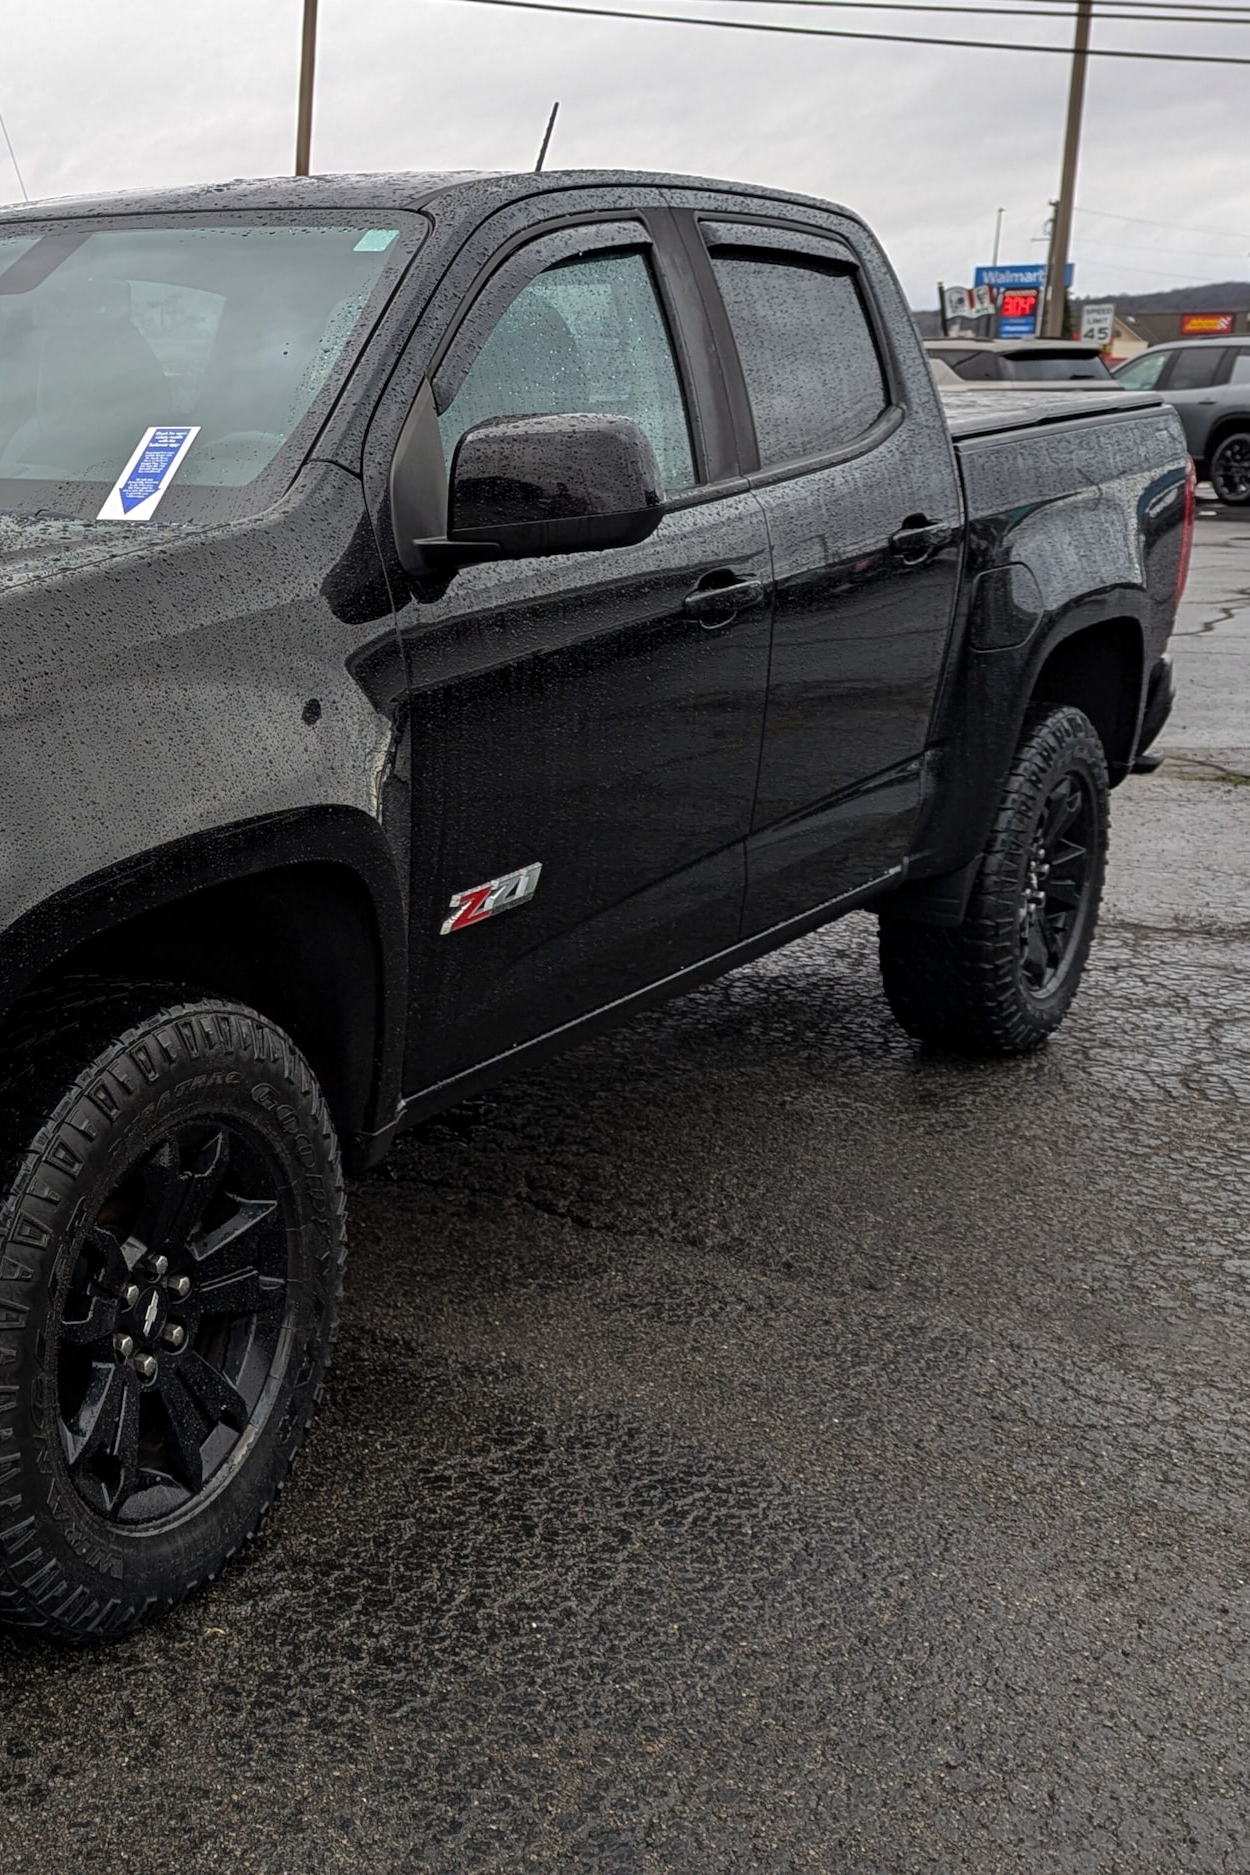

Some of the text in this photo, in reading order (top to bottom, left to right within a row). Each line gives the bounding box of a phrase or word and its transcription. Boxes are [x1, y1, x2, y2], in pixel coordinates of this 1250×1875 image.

[983, 270, 1046, 284] Walmart
[1086, 307, 1112, 315] SPEED
[1084, 327, 1109, 340] 45
[440, 862, 542, 935] Z71
